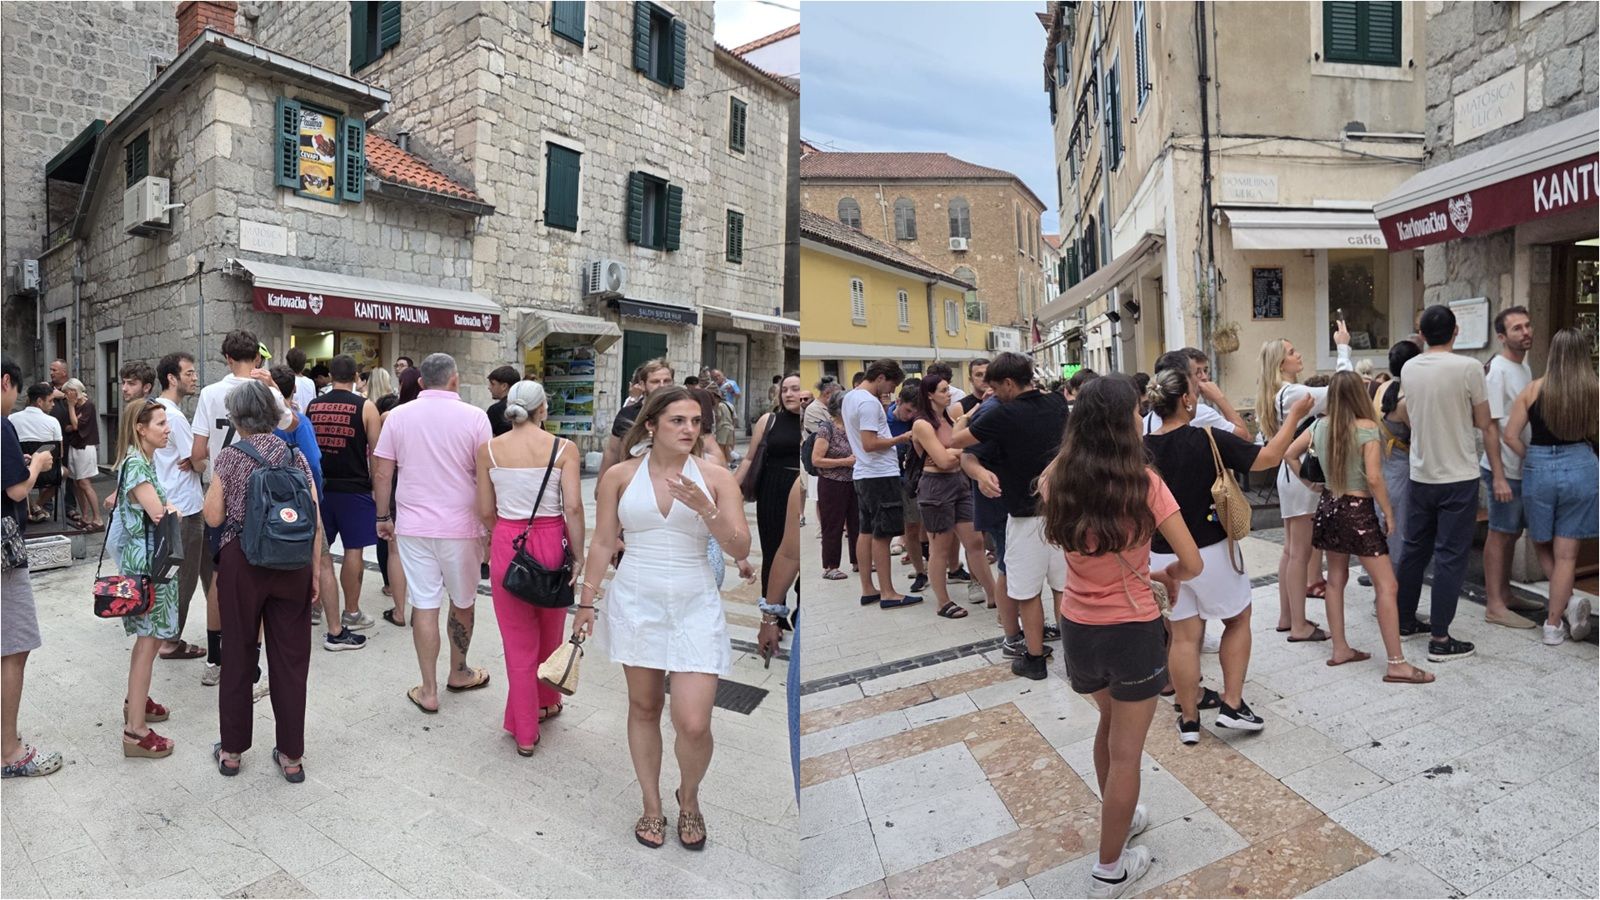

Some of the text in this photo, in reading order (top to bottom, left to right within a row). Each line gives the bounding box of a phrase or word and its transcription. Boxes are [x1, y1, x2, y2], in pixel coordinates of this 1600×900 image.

[1471, 104, 1503, 128] ULICA
[1396, 211, 1447, 241] Karlovačko
[1347, 233, 1381, 245] caffe
[268, 292, 481, 328] Karlovačko KANTUN PAULINA Karlovačko
[321, 403, 356, 413] SCREAM
[312, 414, 349, 423] BECAUSE
[216, 419, 237, 449] 7
[324, 426, 354, 435] WORLD
[318, 437, 345, 446] URNS!
